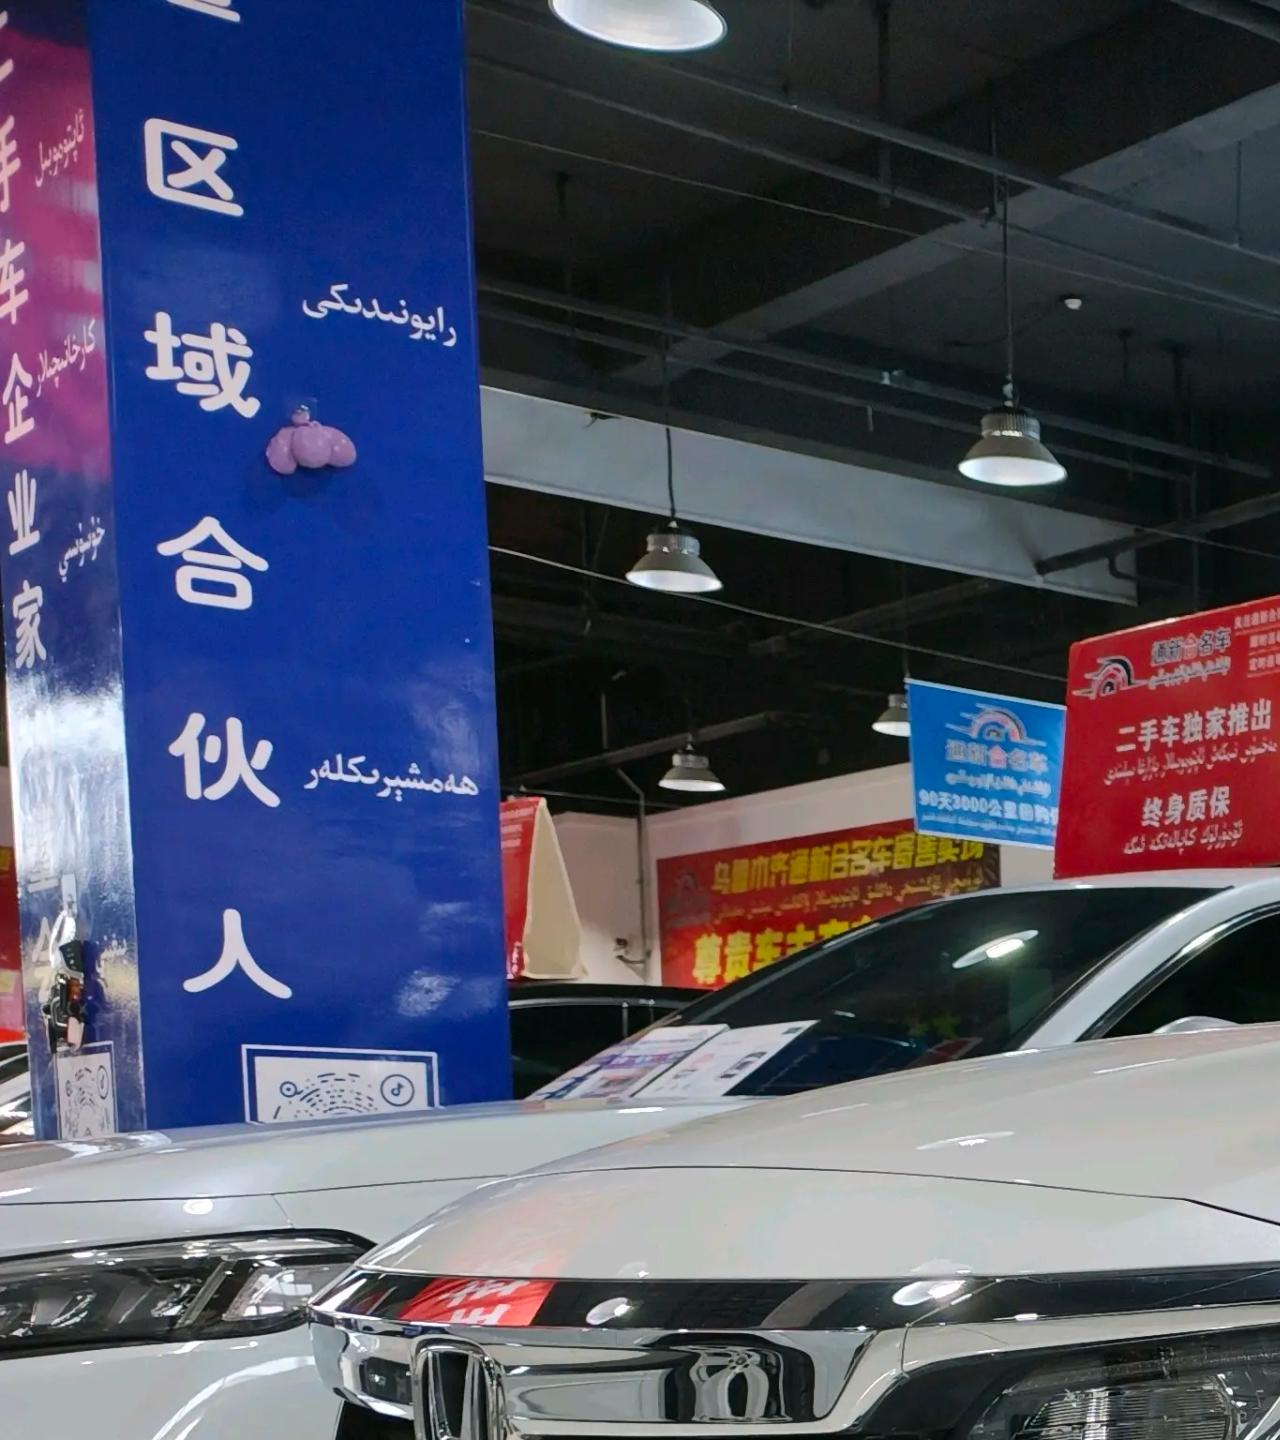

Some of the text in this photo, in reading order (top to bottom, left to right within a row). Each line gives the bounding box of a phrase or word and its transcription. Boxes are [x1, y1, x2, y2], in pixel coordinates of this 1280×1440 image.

[144, 0, 292, 999] 区域合伙人
[1115, 698, 1272, 752] 二手车独家推出
[1141, 785, 1230, 828] 终身质保
